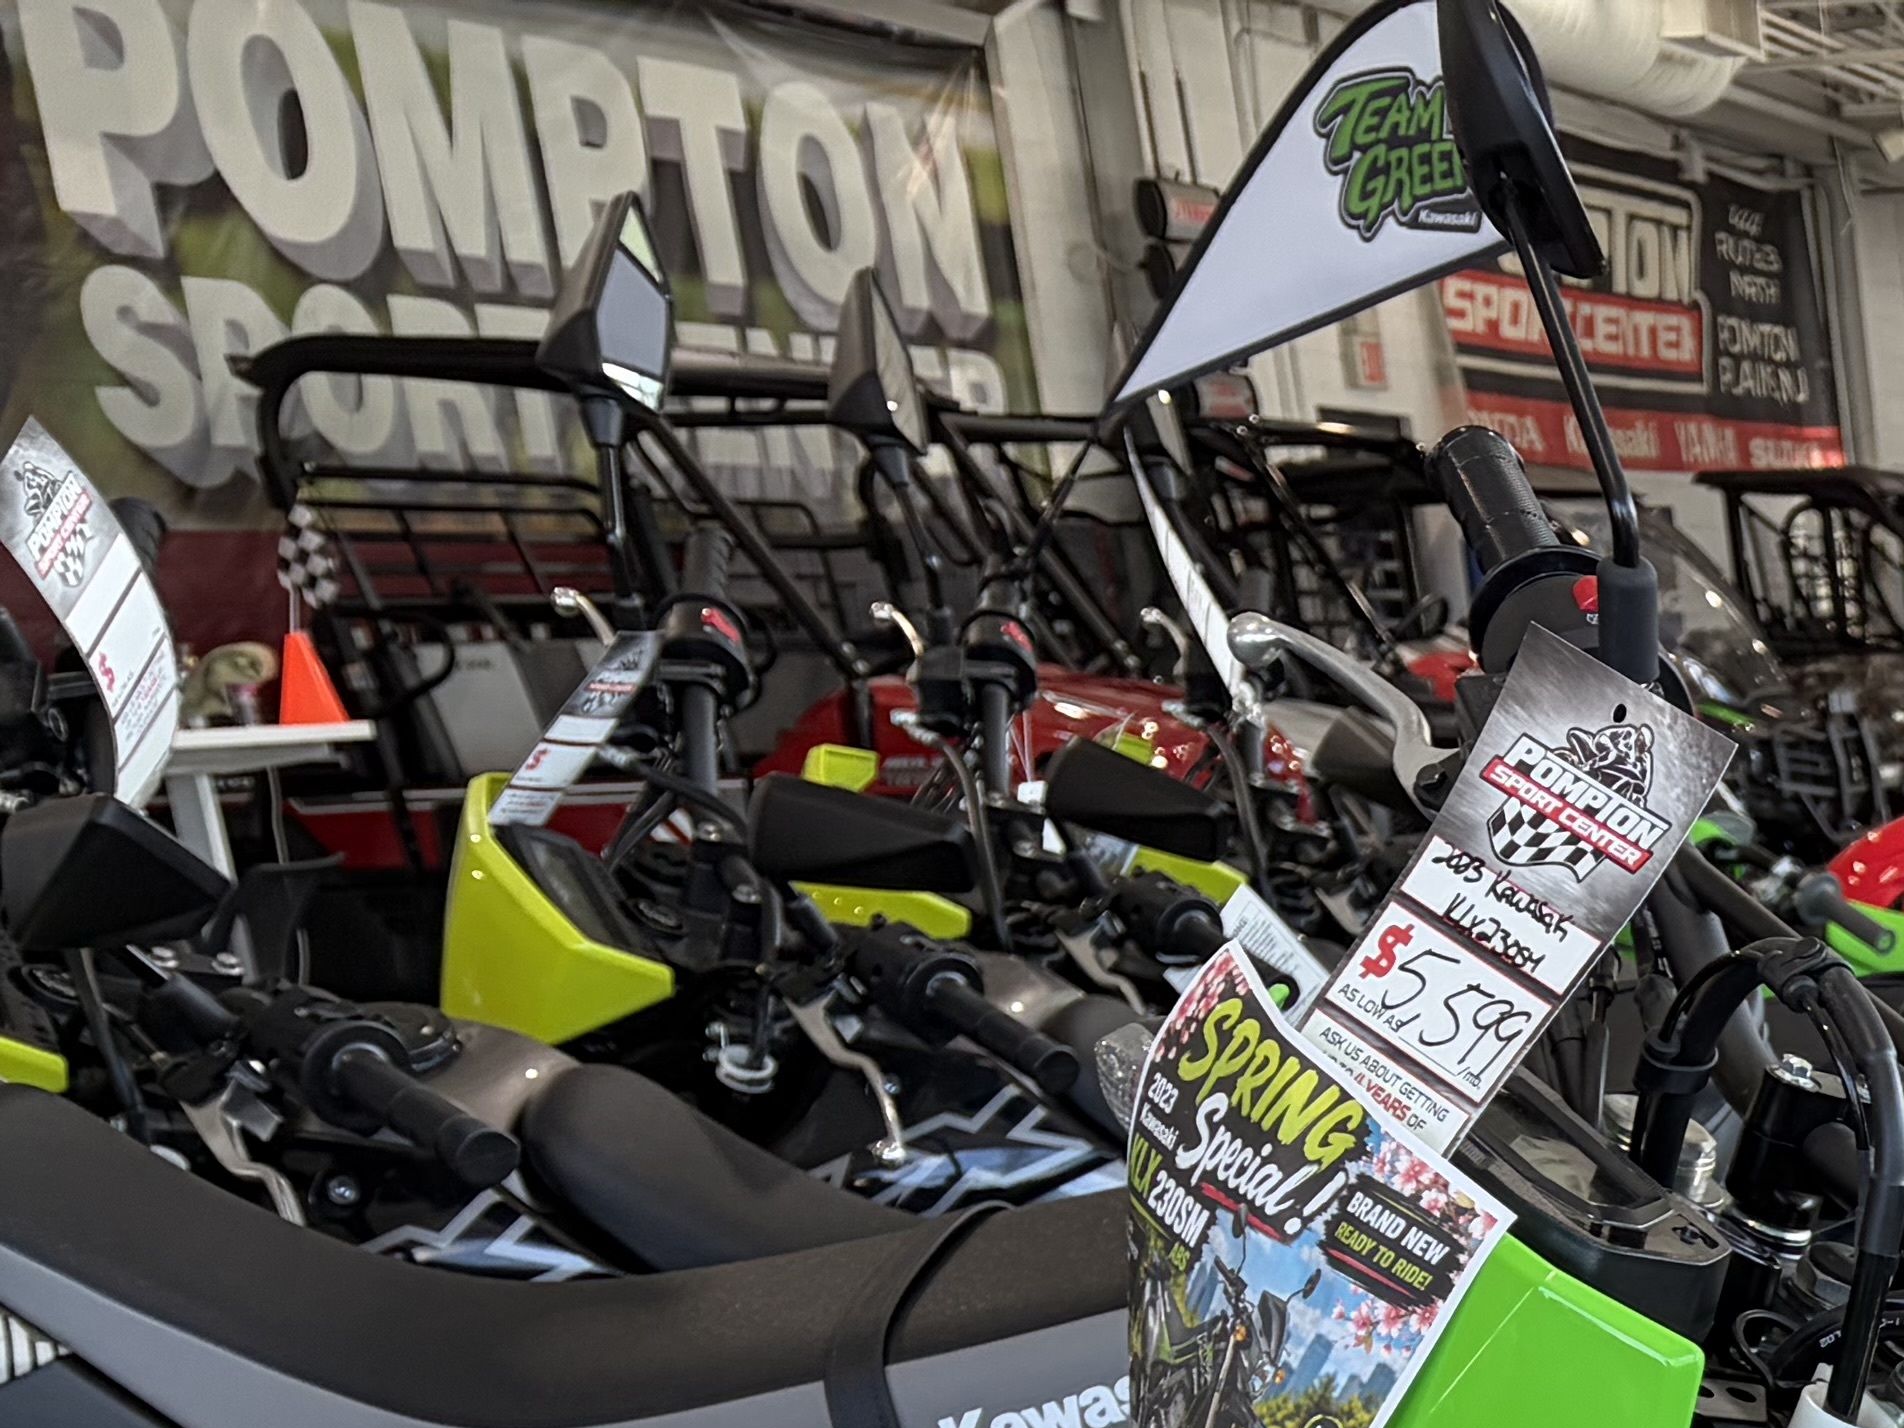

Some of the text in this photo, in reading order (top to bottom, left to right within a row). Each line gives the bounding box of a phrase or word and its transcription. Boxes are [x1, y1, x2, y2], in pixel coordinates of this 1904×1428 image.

[1318, 78, 1444, 163] TEAM
[17, 0, 990, 338] POMPTON
[1418, 208, 1478, 227] Kawasaki
[1442, 277, 1574, 344] SPO
[1489, 764, 1642, 866] SPORT CENTER
[1503, 735, 1669, 850] POMPTON
[1338, 983, 1358, 1003] AS
[1357, 993, 1388, 1020] LOW
[1384, 1015, 1403, 1033] AS
[1147, 1072, 1179, 1114] 2023
[1177, 998, 1364, 1173] SPRING
[1319, 1026, 1345, 1050] ASK
[1346, 1042, 1363, 1062] US
[1359, 1054, 1402, 1089] ABOUT
[1399, 1082, 1451, 1123] GETTING
[1364, 1080, 1412, 1122] YEARS
[1406, 1114, 1428, 1132] OF
[1139, 1101, 1180, 1151] Kawasaki
[1147, 1170, 1210, 1248] 230SM
[1346, 1191, 1450, 1266] BRAND NEW
[1169, 1241, 1191, 1271] ABS
[1334, 1221, 1434, 1291] READY TO RIDE!
